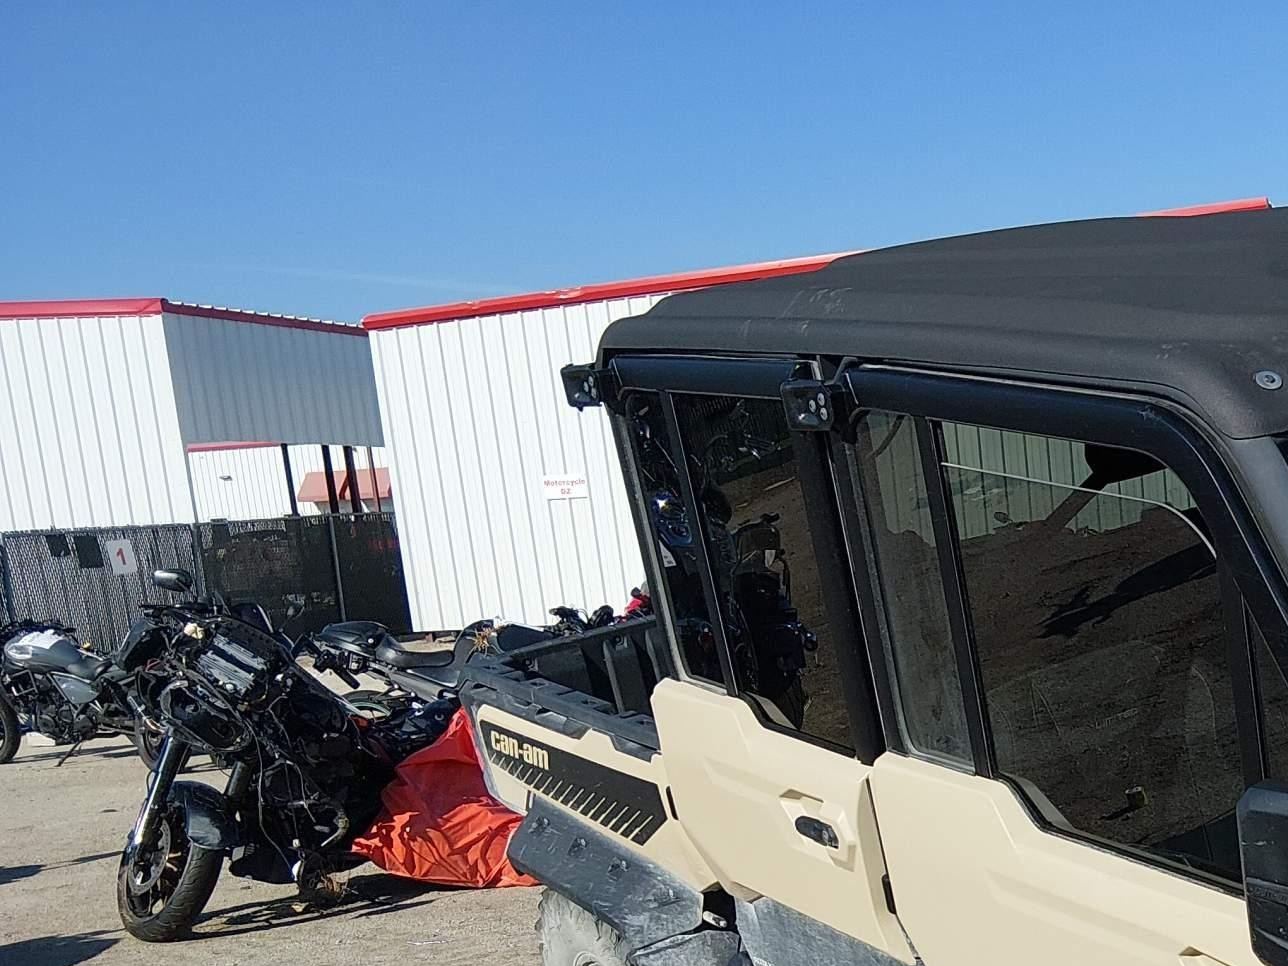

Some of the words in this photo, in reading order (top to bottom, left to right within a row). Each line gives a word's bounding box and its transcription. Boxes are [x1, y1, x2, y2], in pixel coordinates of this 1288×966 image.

[543, 477, 586, 487] Motorcycle
[116, 547, 126, 566] 1
[490, 730, 549, 770] can-am
